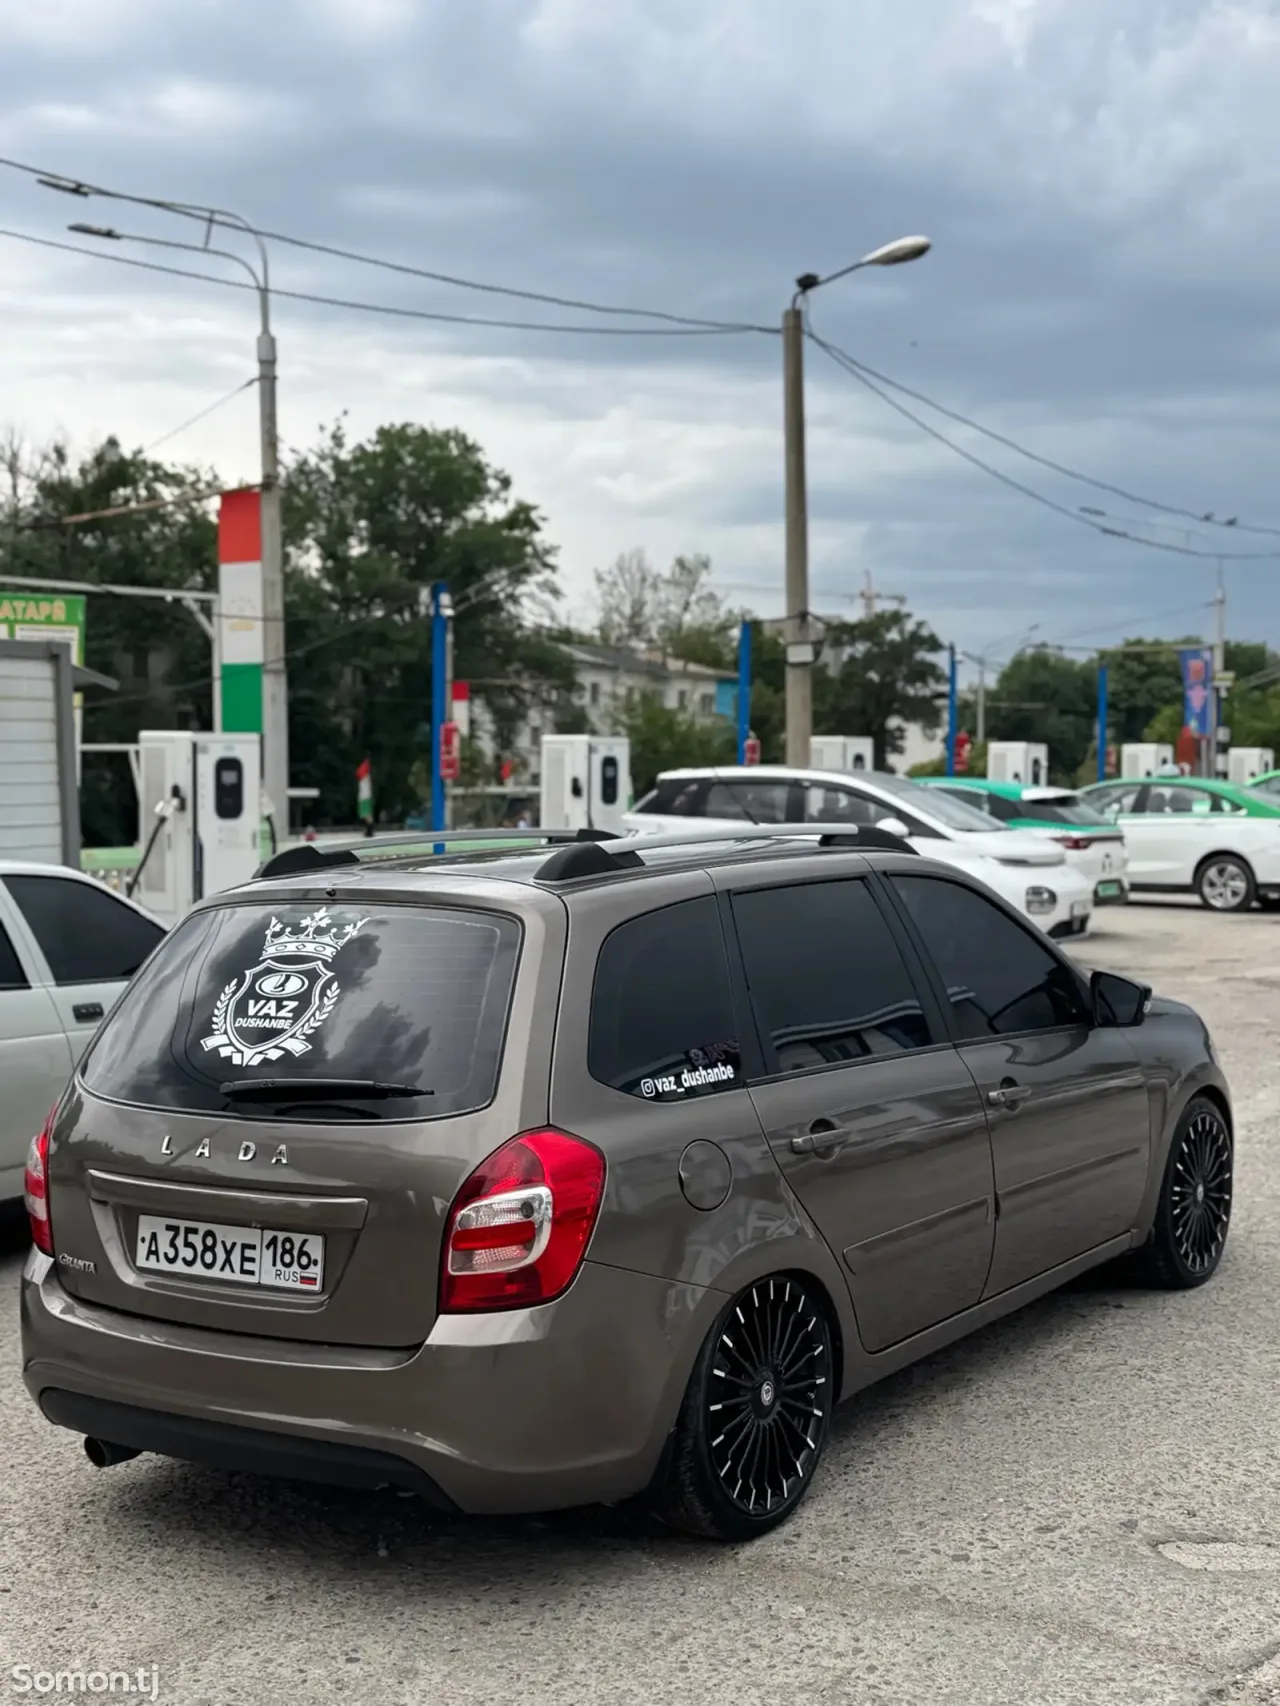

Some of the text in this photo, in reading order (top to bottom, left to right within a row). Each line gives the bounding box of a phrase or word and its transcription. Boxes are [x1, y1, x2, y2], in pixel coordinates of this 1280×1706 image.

[248, 999, 300, 1018] VAZ
[234, 1017, 293, 1030] DUSHANBE
[654, 1062, 735, 1093] vaz_dushanbe
[161, 1135, 289, 1165] LADA
[145, 1223, 312, 1277] А358ХЕ 186
[274, 1269, 299, 1283] RUS
